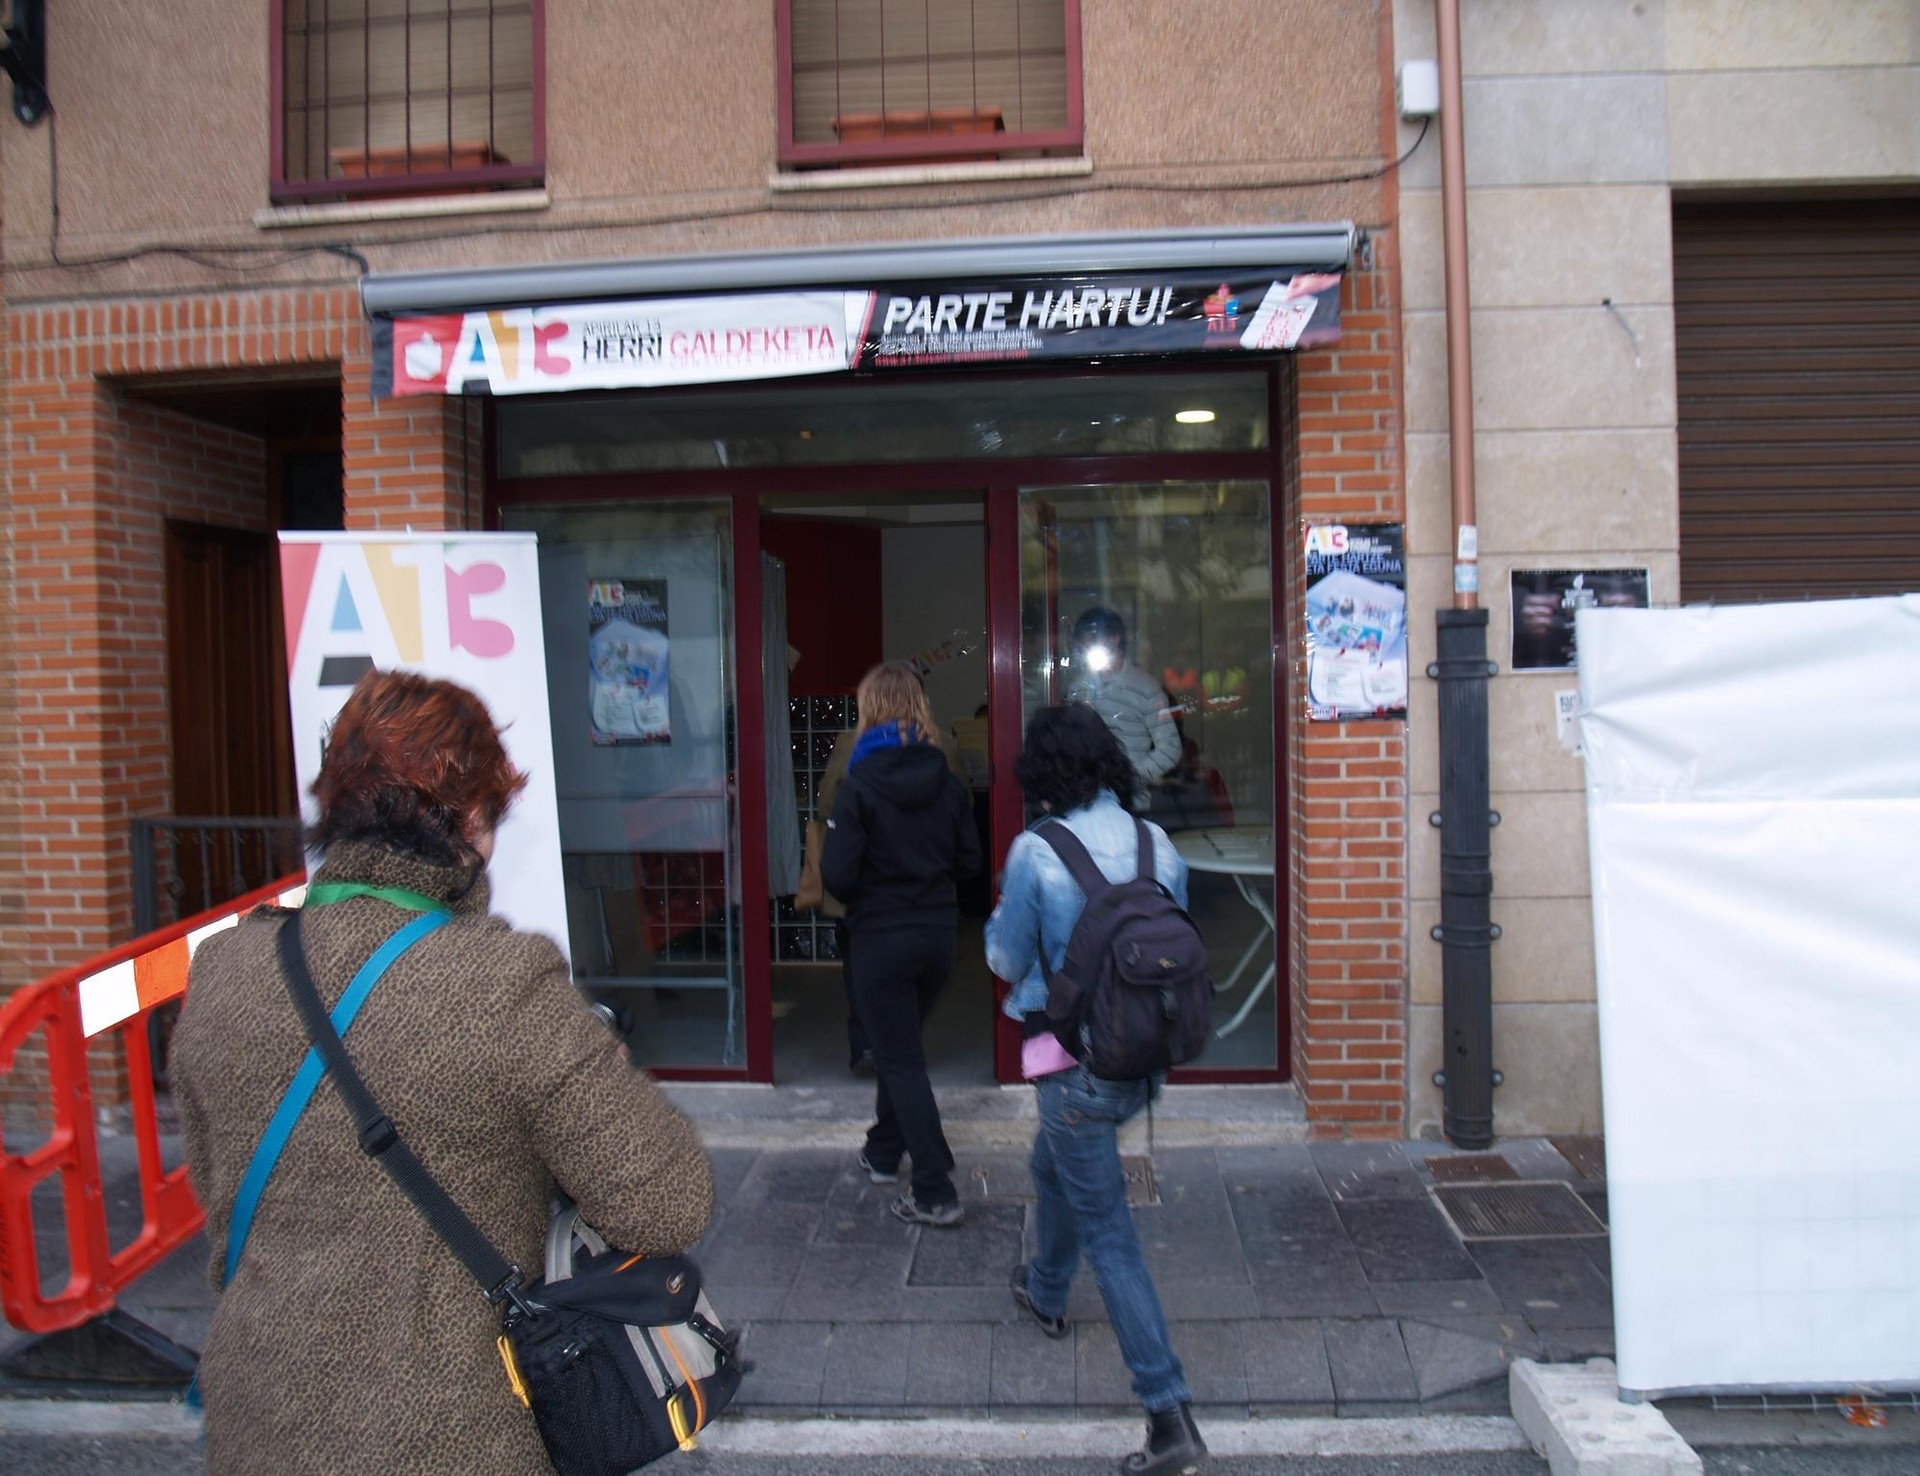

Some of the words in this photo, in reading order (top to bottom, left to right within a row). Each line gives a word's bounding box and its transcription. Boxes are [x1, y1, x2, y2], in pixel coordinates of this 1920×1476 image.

[883, 291, 1013, 335] PARTE
[1019, 285, 1173, 330] HARTU!
[582, 335, 662, 361] HERRI
[669, 323, 836, 358] GALDEKETA
